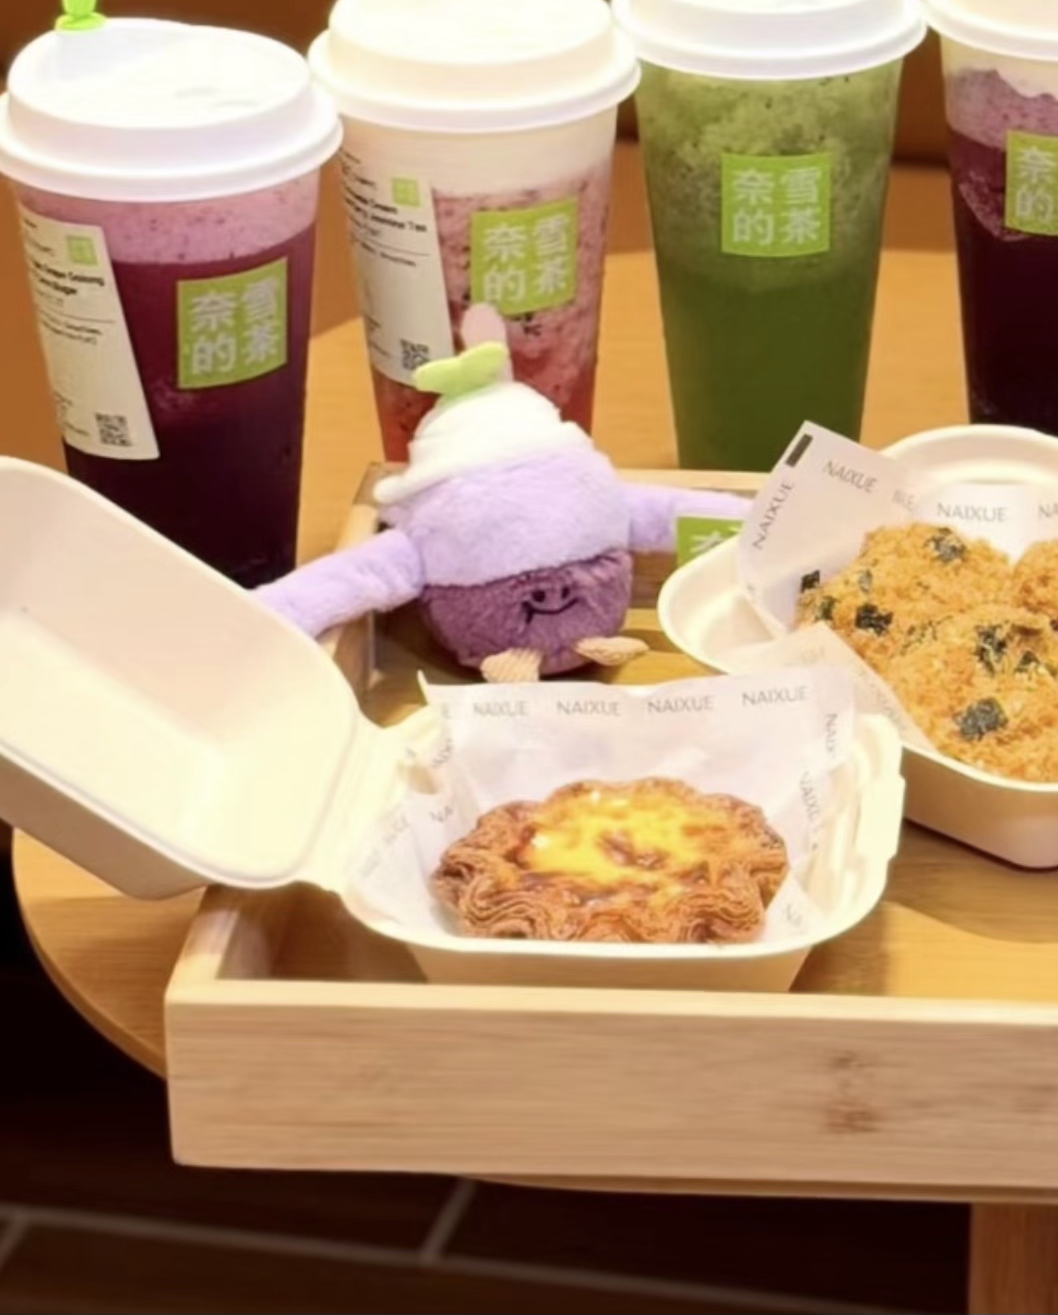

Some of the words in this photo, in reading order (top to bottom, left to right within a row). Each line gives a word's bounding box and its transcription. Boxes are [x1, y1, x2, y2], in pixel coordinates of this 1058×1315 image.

[733, 166, 822, 206] 奈雪
[483, 212, 570, 261] 奈雪
[732, 207, 822, 246] 的茶
[483, 258, 568, 303] 的茶
[192, 275, 278, 332] 奈雪
[192, 322, 278, 376] 的茶
[752, 481, 794, 550] NAIXUE
[937, 503, 1006, 522] NAIXUE
[473, 700, 528, 717] NAIXUE
[556, 700, 620, 716] NAIXUE
[647, 696, 714, 714] NAIXUE
[742, 686, 808, 706] NAIXUE
